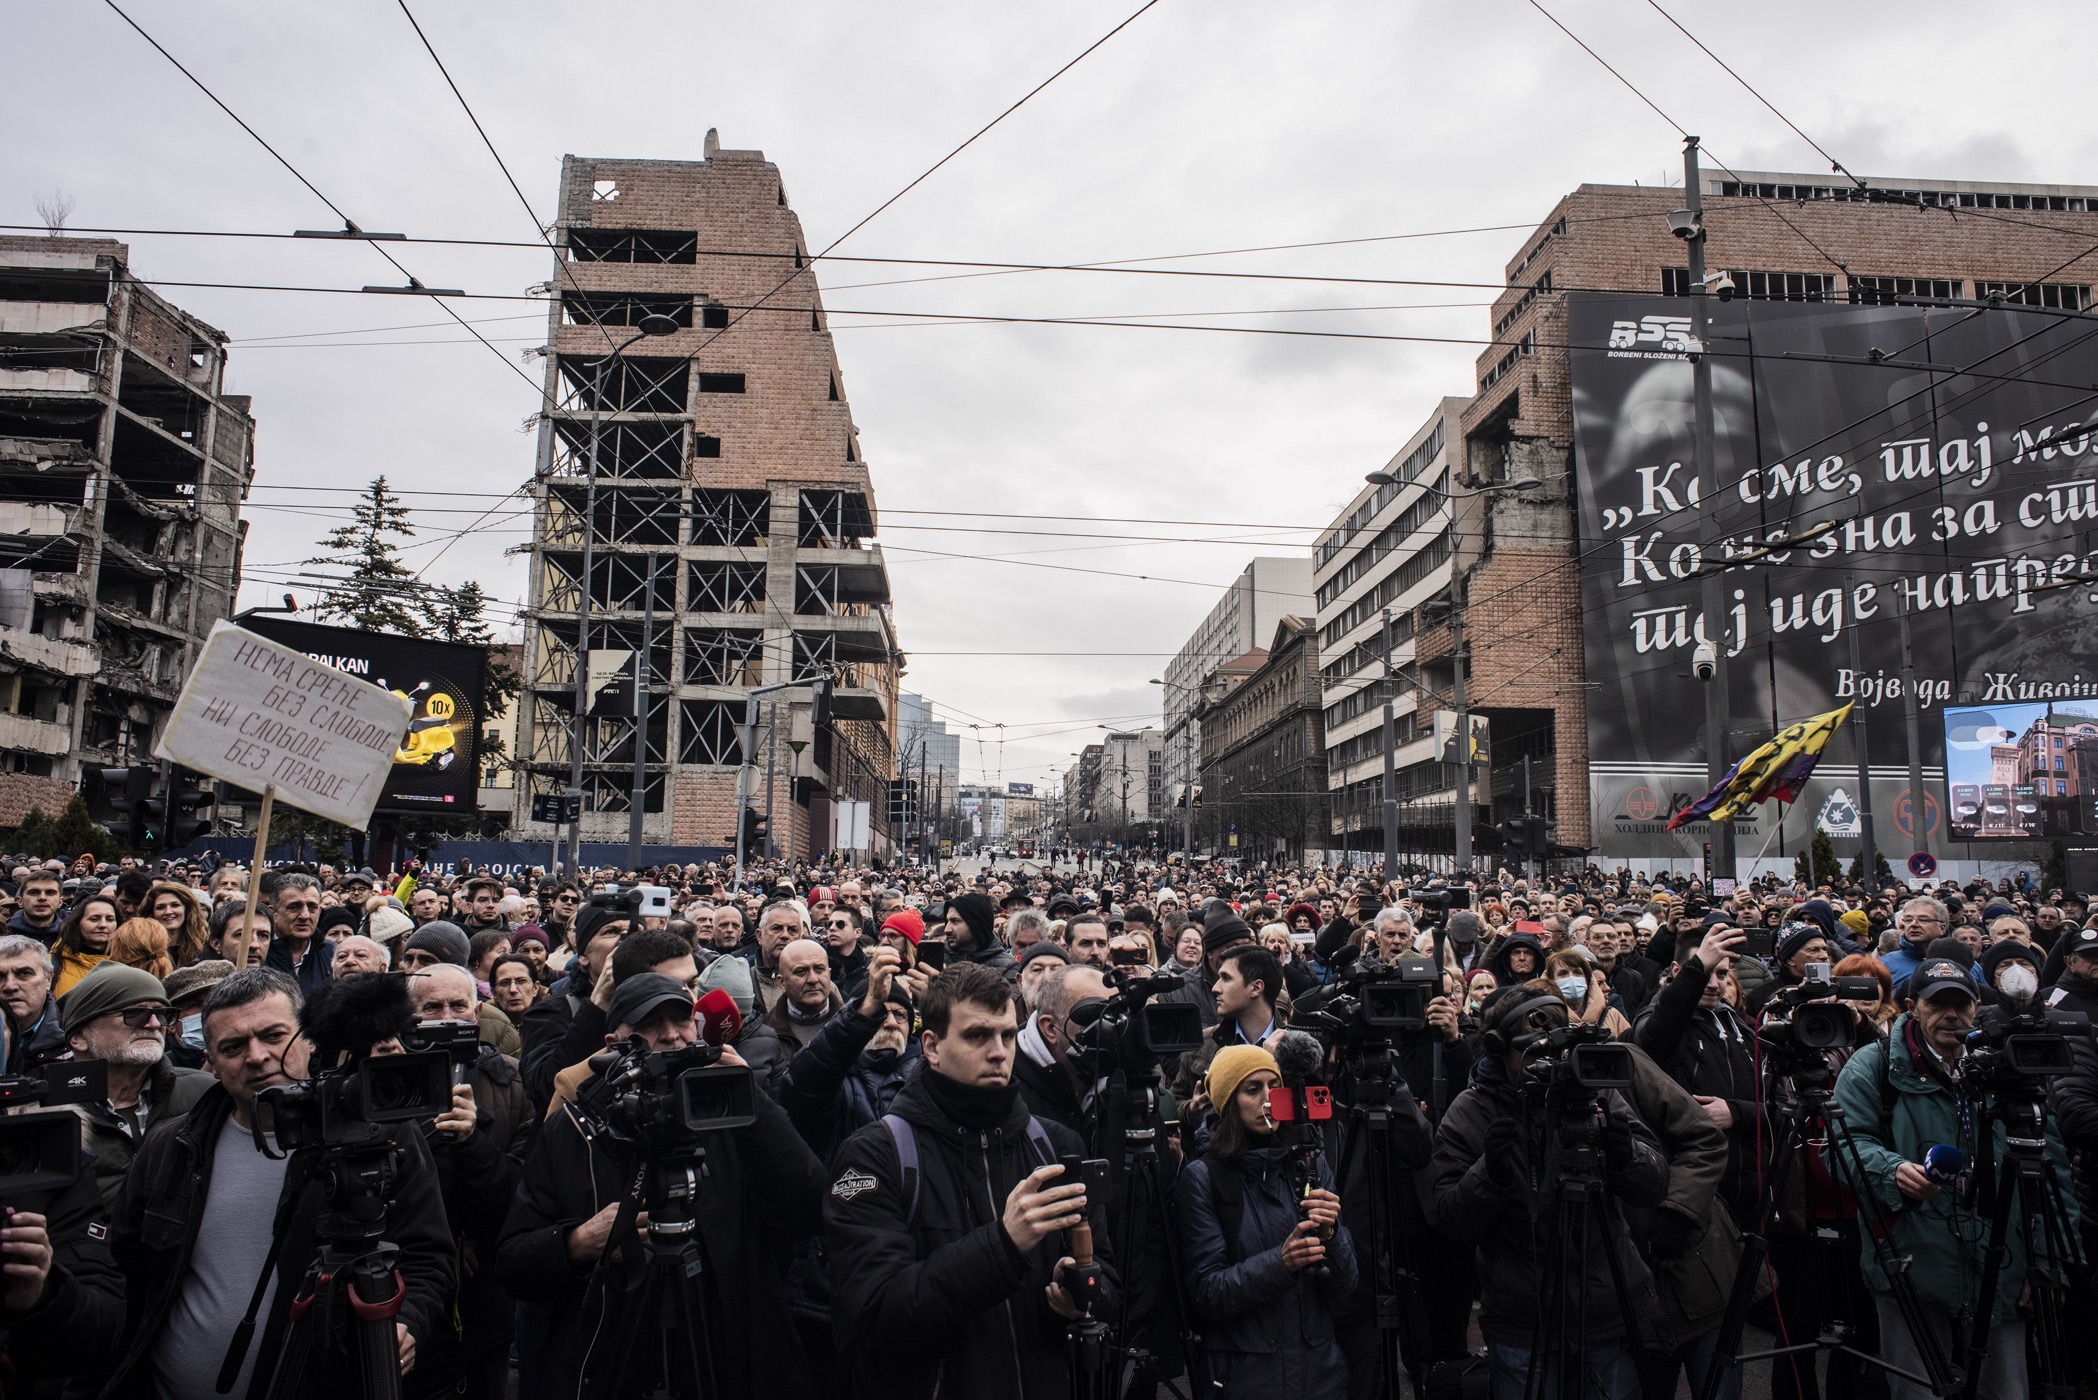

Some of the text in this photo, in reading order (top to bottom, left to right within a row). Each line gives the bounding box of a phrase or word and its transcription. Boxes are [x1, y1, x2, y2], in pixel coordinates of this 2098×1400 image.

[1643, 352, 1676, 360] SLOŽENI
[1739, 455, 1862, 503] сме,
[2011, 422, 2098, 465] мо
[1617, 531, 1702, 587] Ко
[1809, 511, 1917, 559] зна
[1931, 499, 2002, 541] за
[1770, 583, 1879, 644] иде
[1893, 549, 2098, 613] напре
[233, 640, 368, 711] НЕМА СРЕЋЕ
[261, 685, 307, 718] БЕЗ
[201, 696, 332, 763] НИ СЛОБОДЕ
[224, 738, 271, 771] БЕЗ
[67, 1076, 87, 1084] 4K
[631, 1162, 647, 1199] SONY
